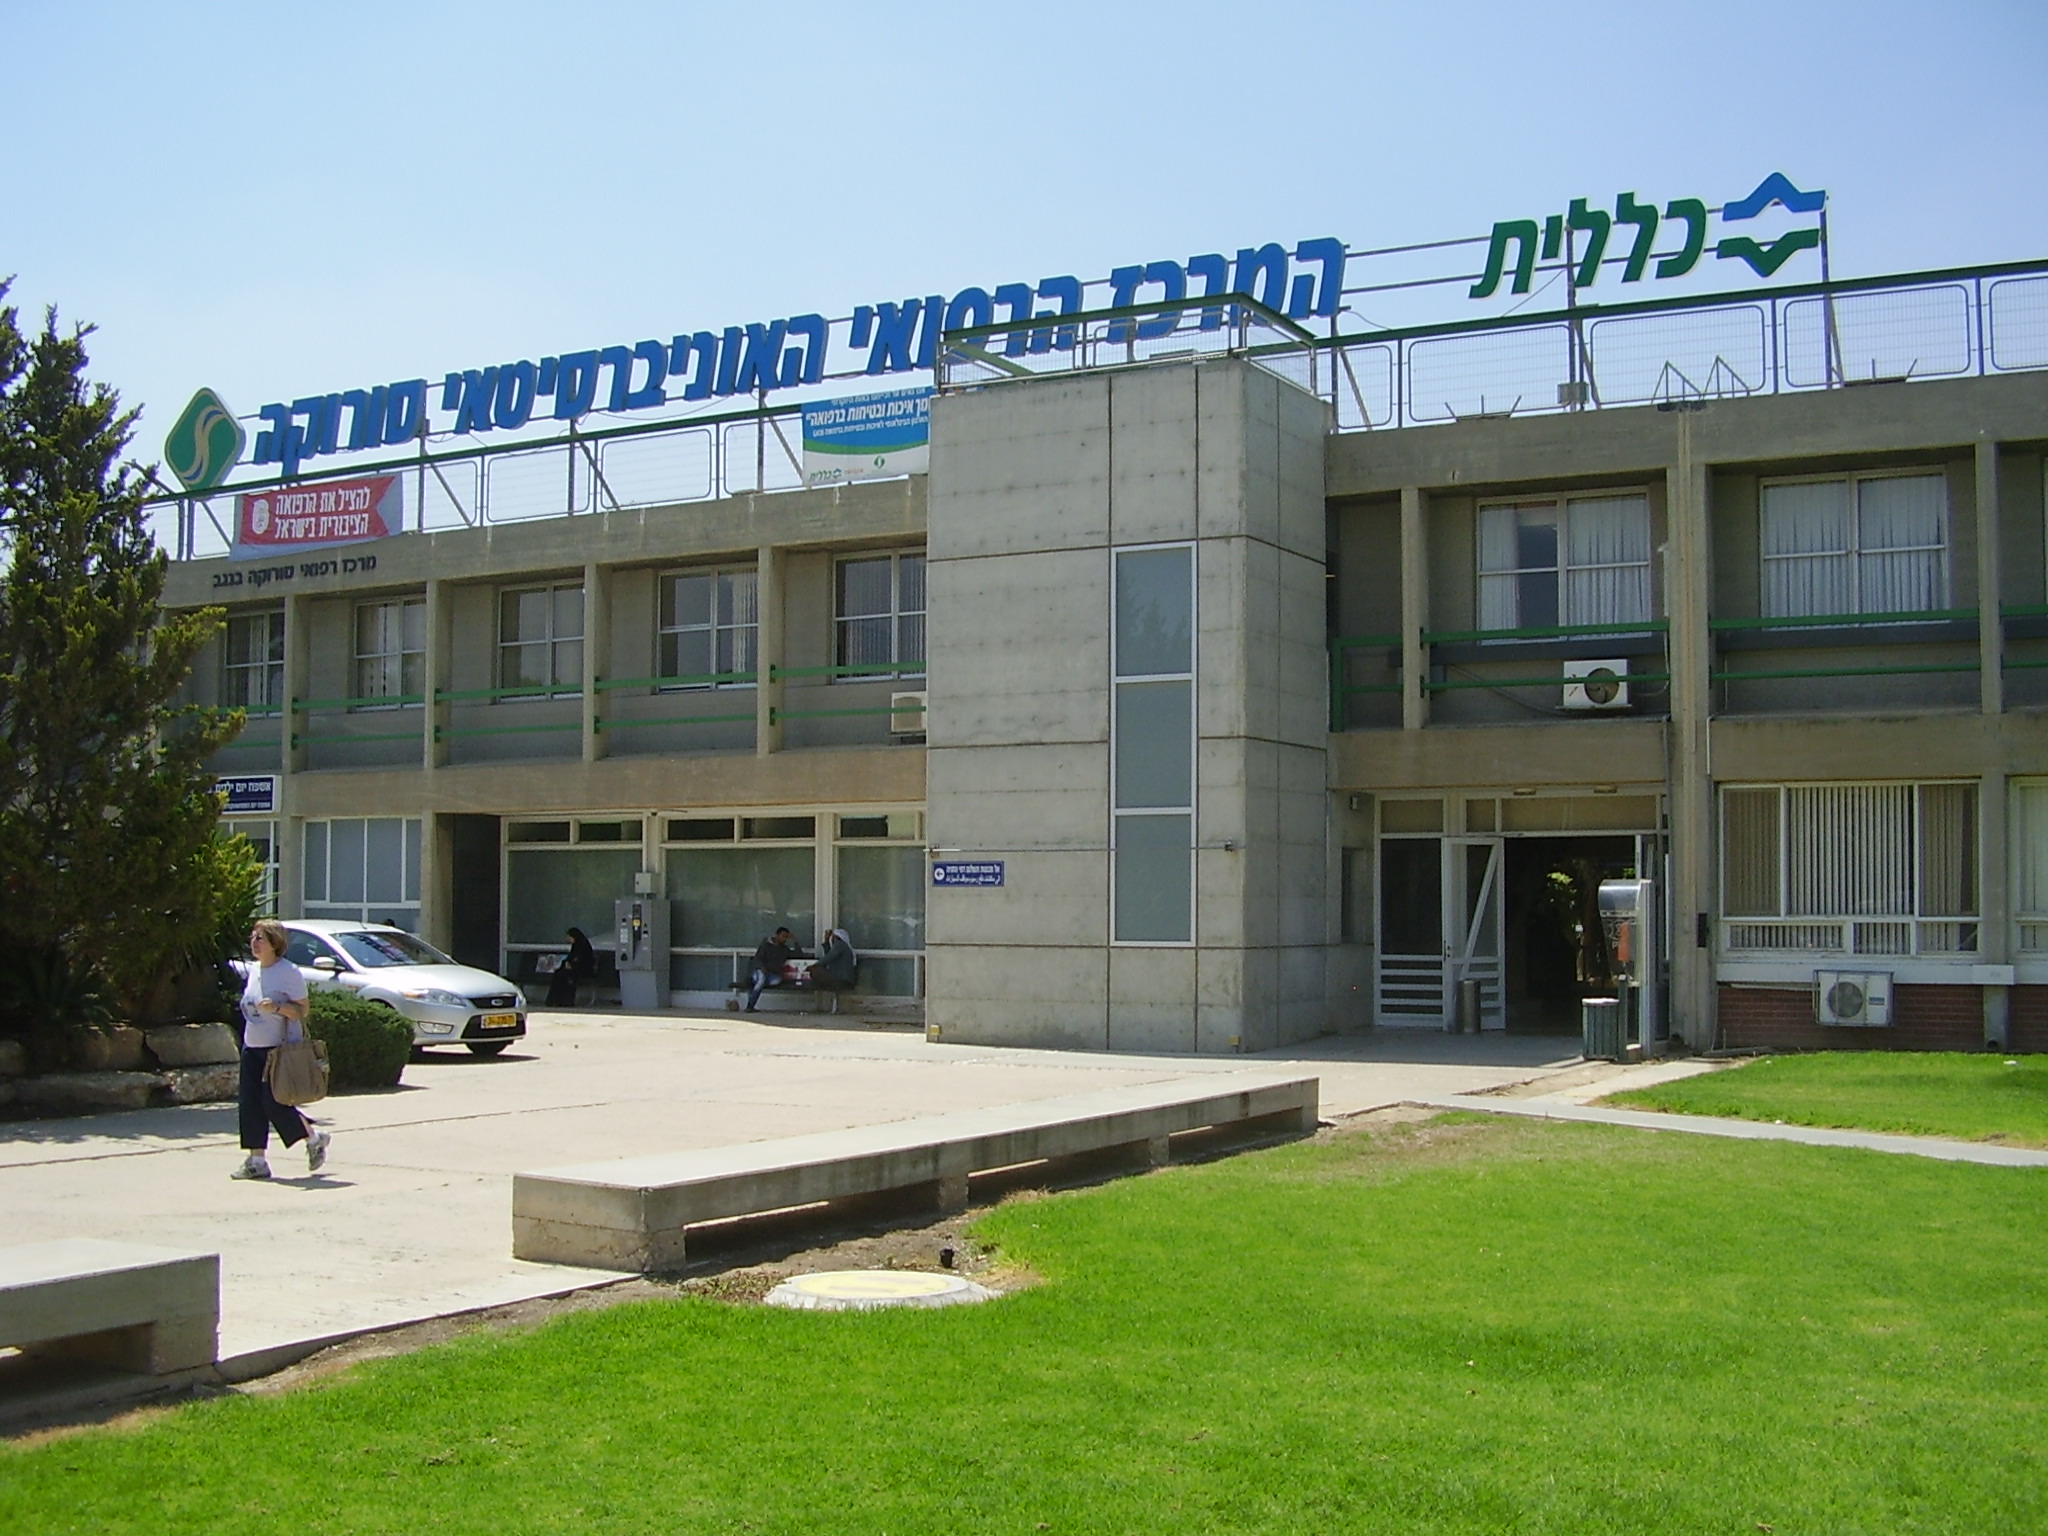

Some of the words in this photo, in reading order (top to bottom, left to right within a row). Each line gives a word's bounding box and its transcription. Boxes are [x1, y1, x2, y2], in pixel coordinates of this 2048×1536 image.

[1469, 191, 1707, 299] כללית
[1105, 237, 1347, 345] המרכז
[850, 275, 1083, 374] הרפואי
[441, 312, 829, 434] האוניברסיטאי
[847, 403, 886, 422] ובטיחות
[886, 400, 914, 417] איכות
[255, 379, 429, 477] סורוקה
[275, 493, 317, 515] הרפואה
[319, 490, 337, 513] את
[338, 486, 371, 512] להציל
[274, 516, 316, 539] בישראל
[319, 513, 369, 537] הציבורית
[300, 561, 338, 578] רפואי
[342, 555, 377, 573] מרכז
[248, 565, 295, 588] סורוקה
